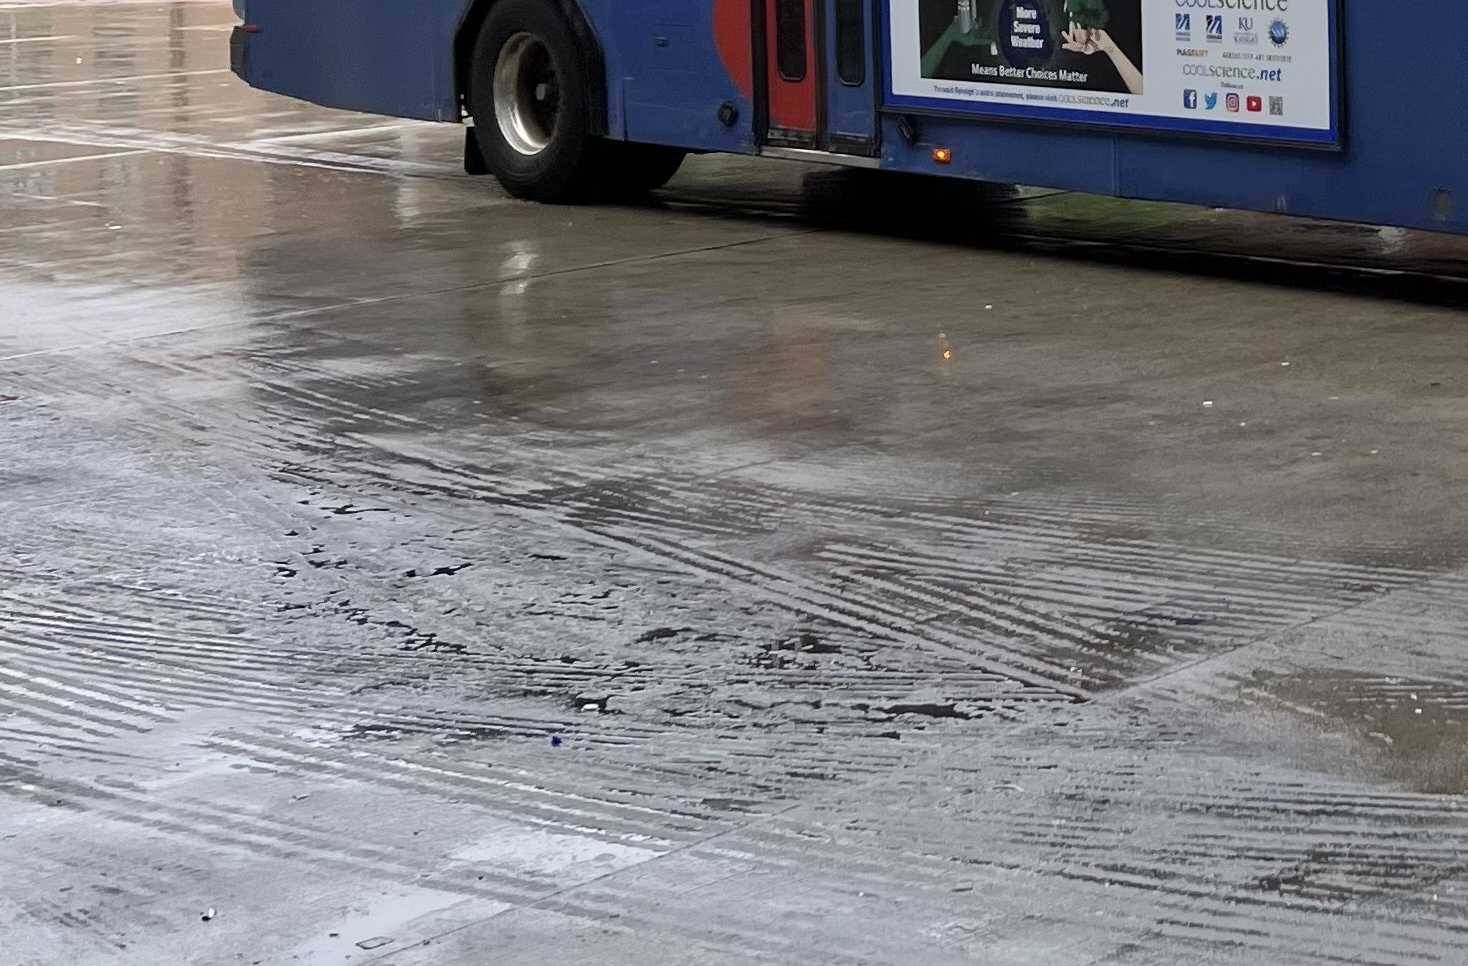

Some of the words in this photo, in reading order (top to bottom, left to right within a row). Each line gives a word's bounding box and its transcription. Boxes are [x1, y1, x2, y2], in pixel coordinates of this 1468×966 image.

[1016, 6, 1037, 20] More
[1013, 21, 1041, 34] Severe
[1238, 16, 1254, 31] KU
[1011, 35, 1044, 49] Weather
[971, 63, 997, 76] Means
[999, 65, 1025, 78] Better
[1026, 67, 1057, 80] Choices
[1059, 70, 1088, 83] Matter
